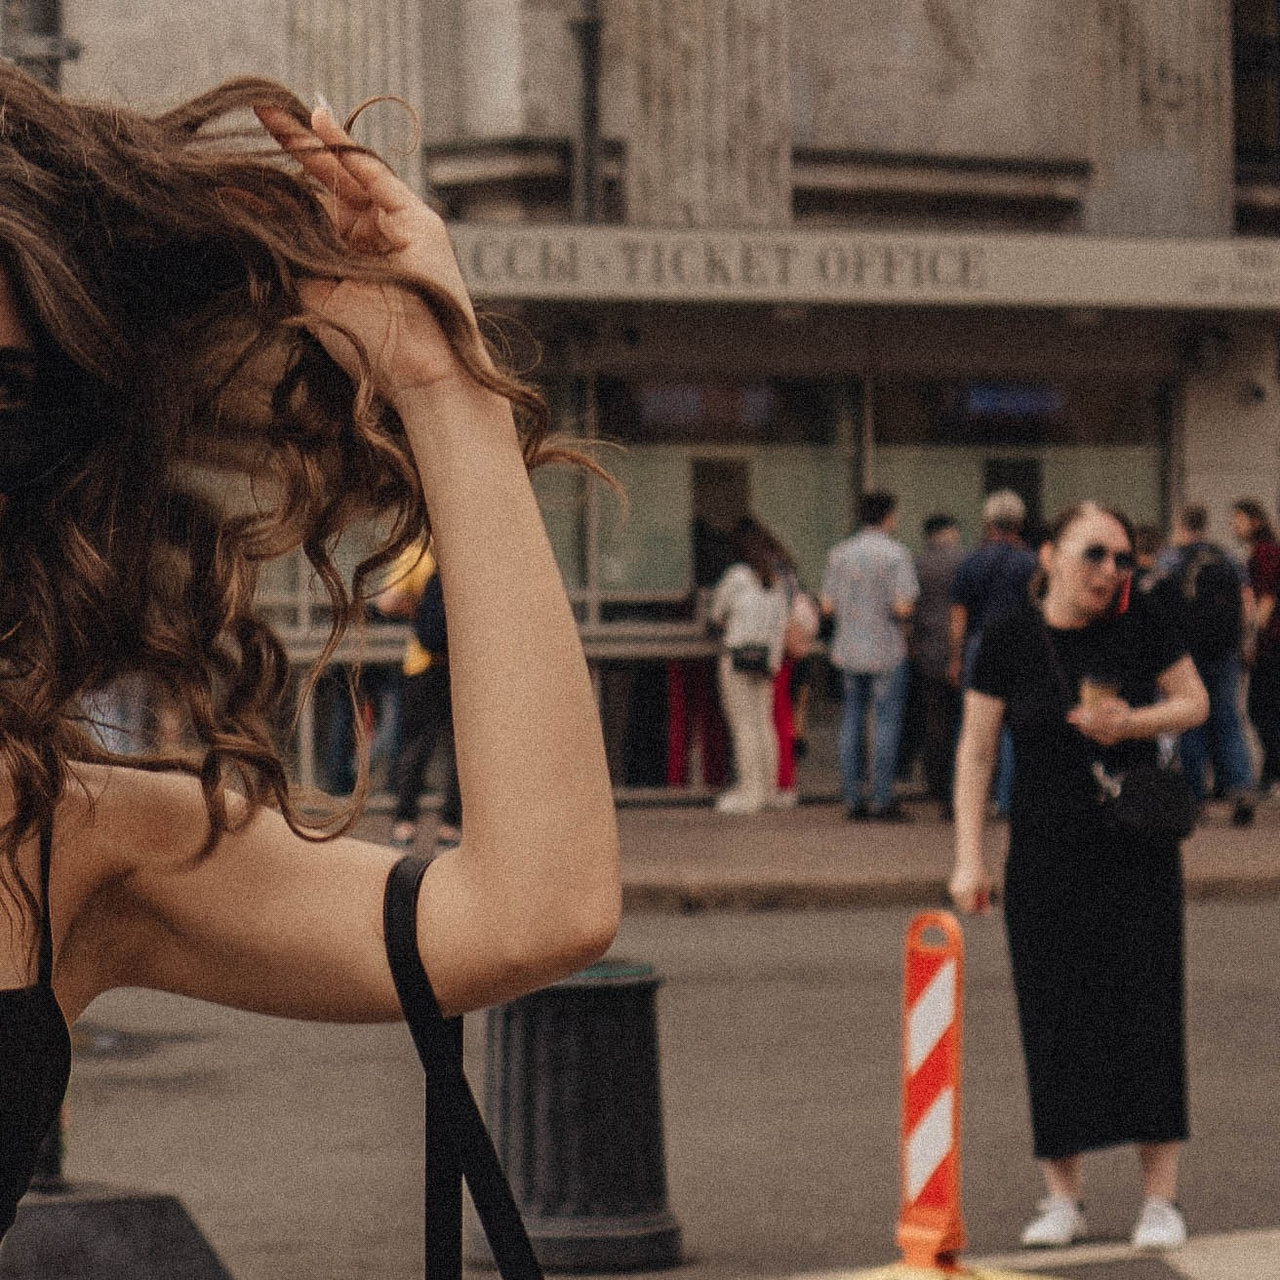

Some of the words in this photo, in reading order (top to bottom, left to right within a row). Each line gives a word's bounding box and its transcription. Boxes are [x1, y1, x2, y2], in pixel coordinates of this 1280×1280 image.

[471, 237, 580, 282] ССЫ
[617, 239, 798, 286] TICKET
[817, 243, 987, 290] OFFICE
